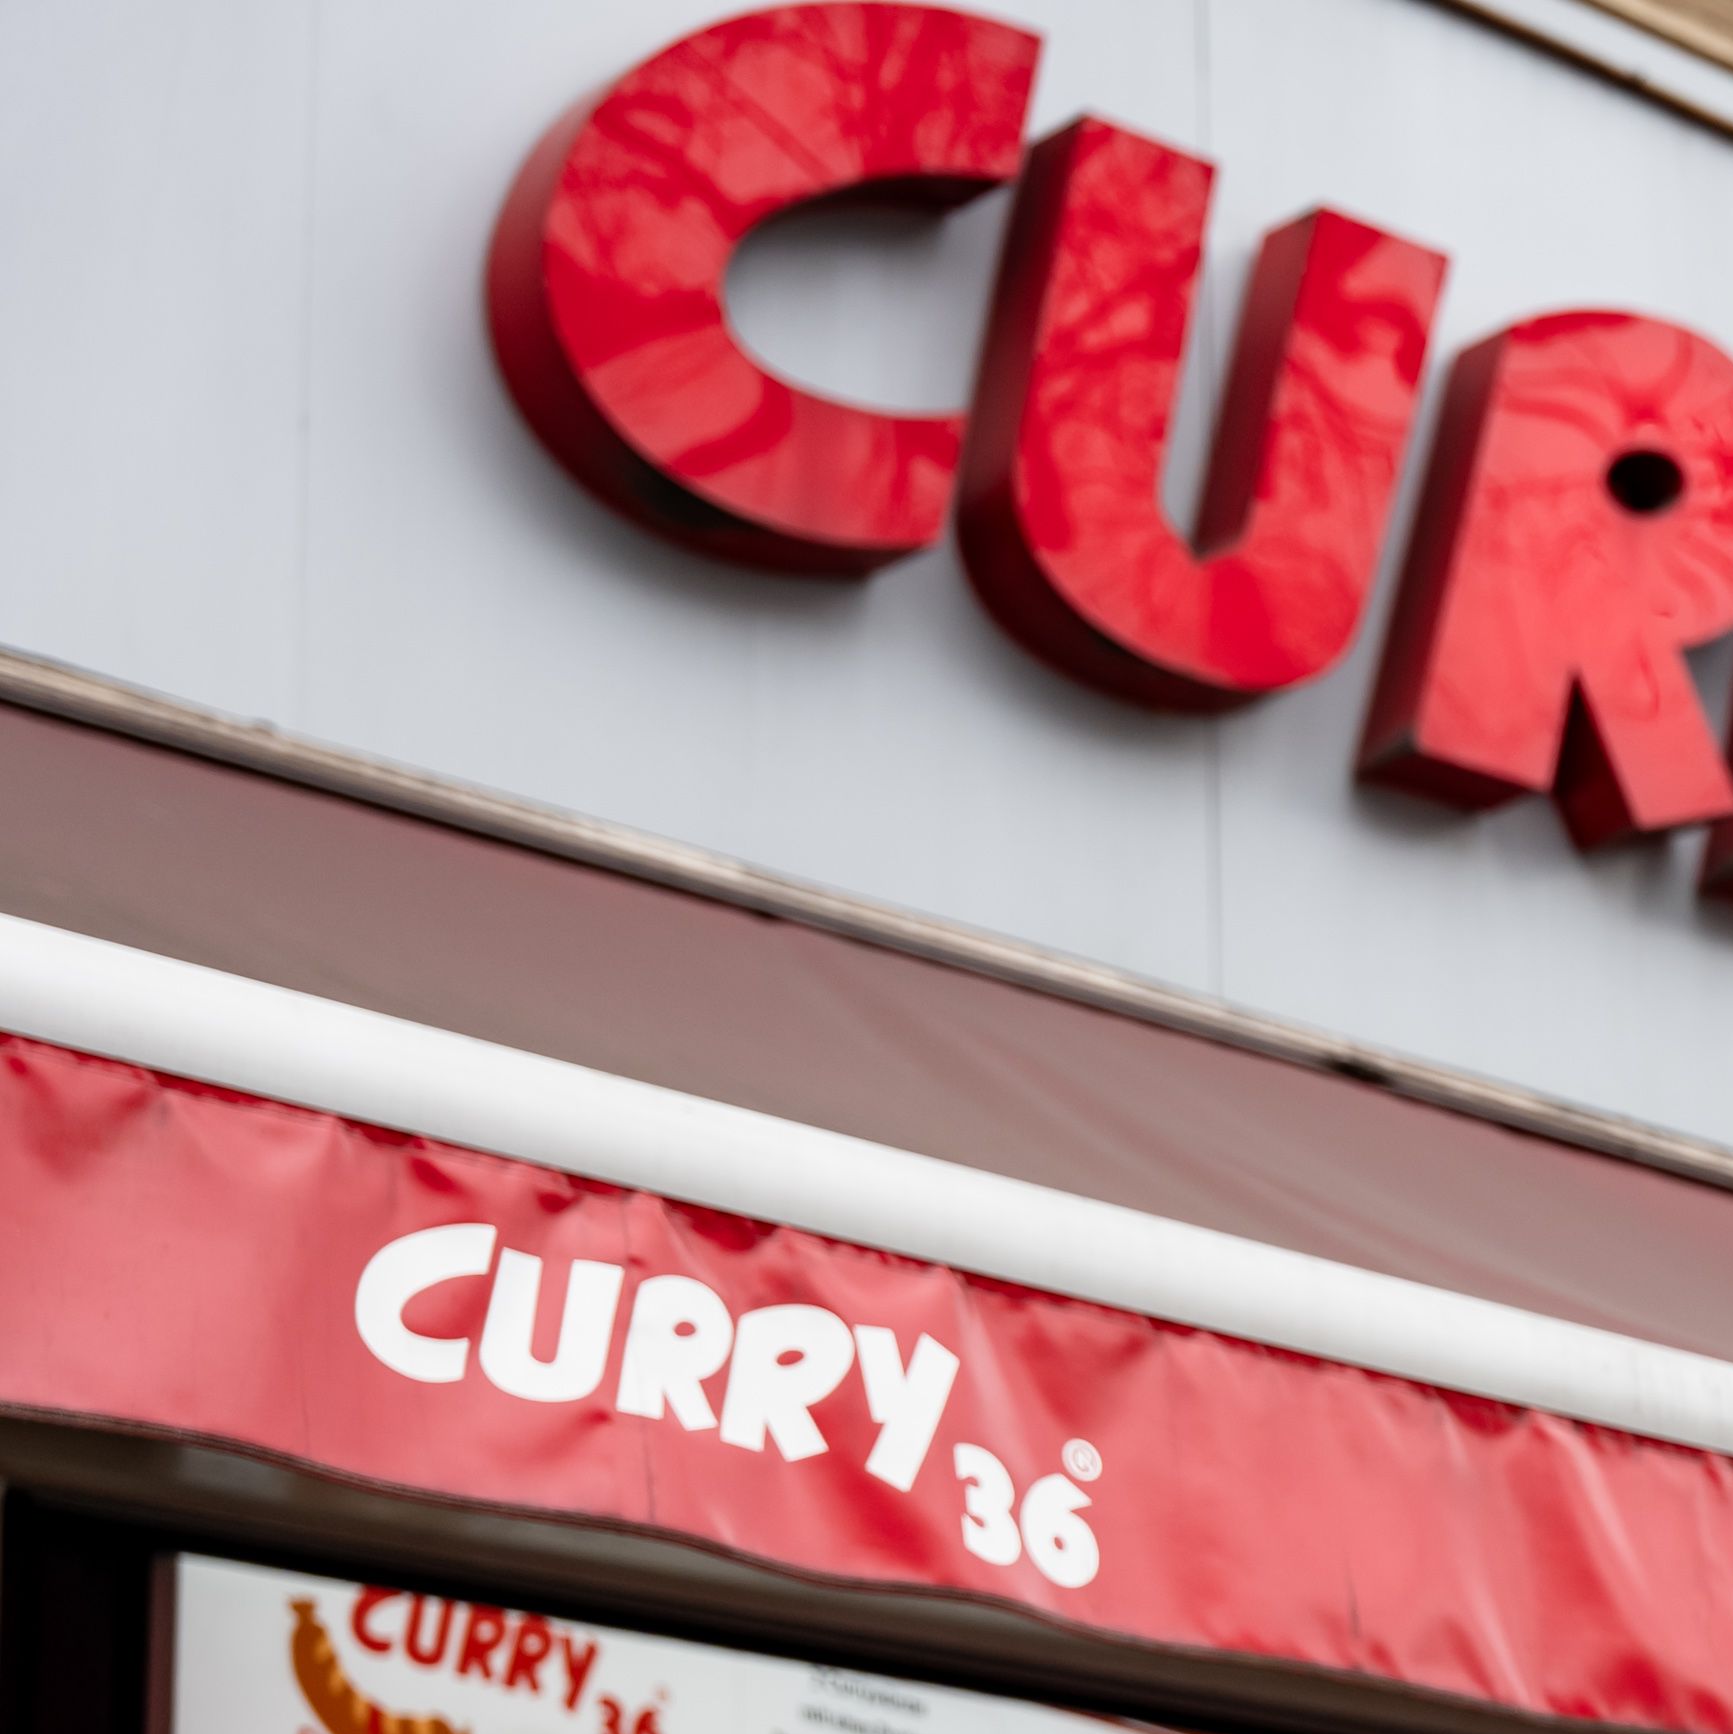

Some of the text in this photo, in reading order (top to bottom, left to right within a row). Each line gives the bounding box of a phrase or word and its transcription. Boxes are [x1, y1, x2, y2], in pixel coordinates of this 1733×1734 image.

[353, 1222, 961, 1493] CURRY
[953, 1441, 1101, 1590] 36
[349, 1583, 600, 1713] CURRY
